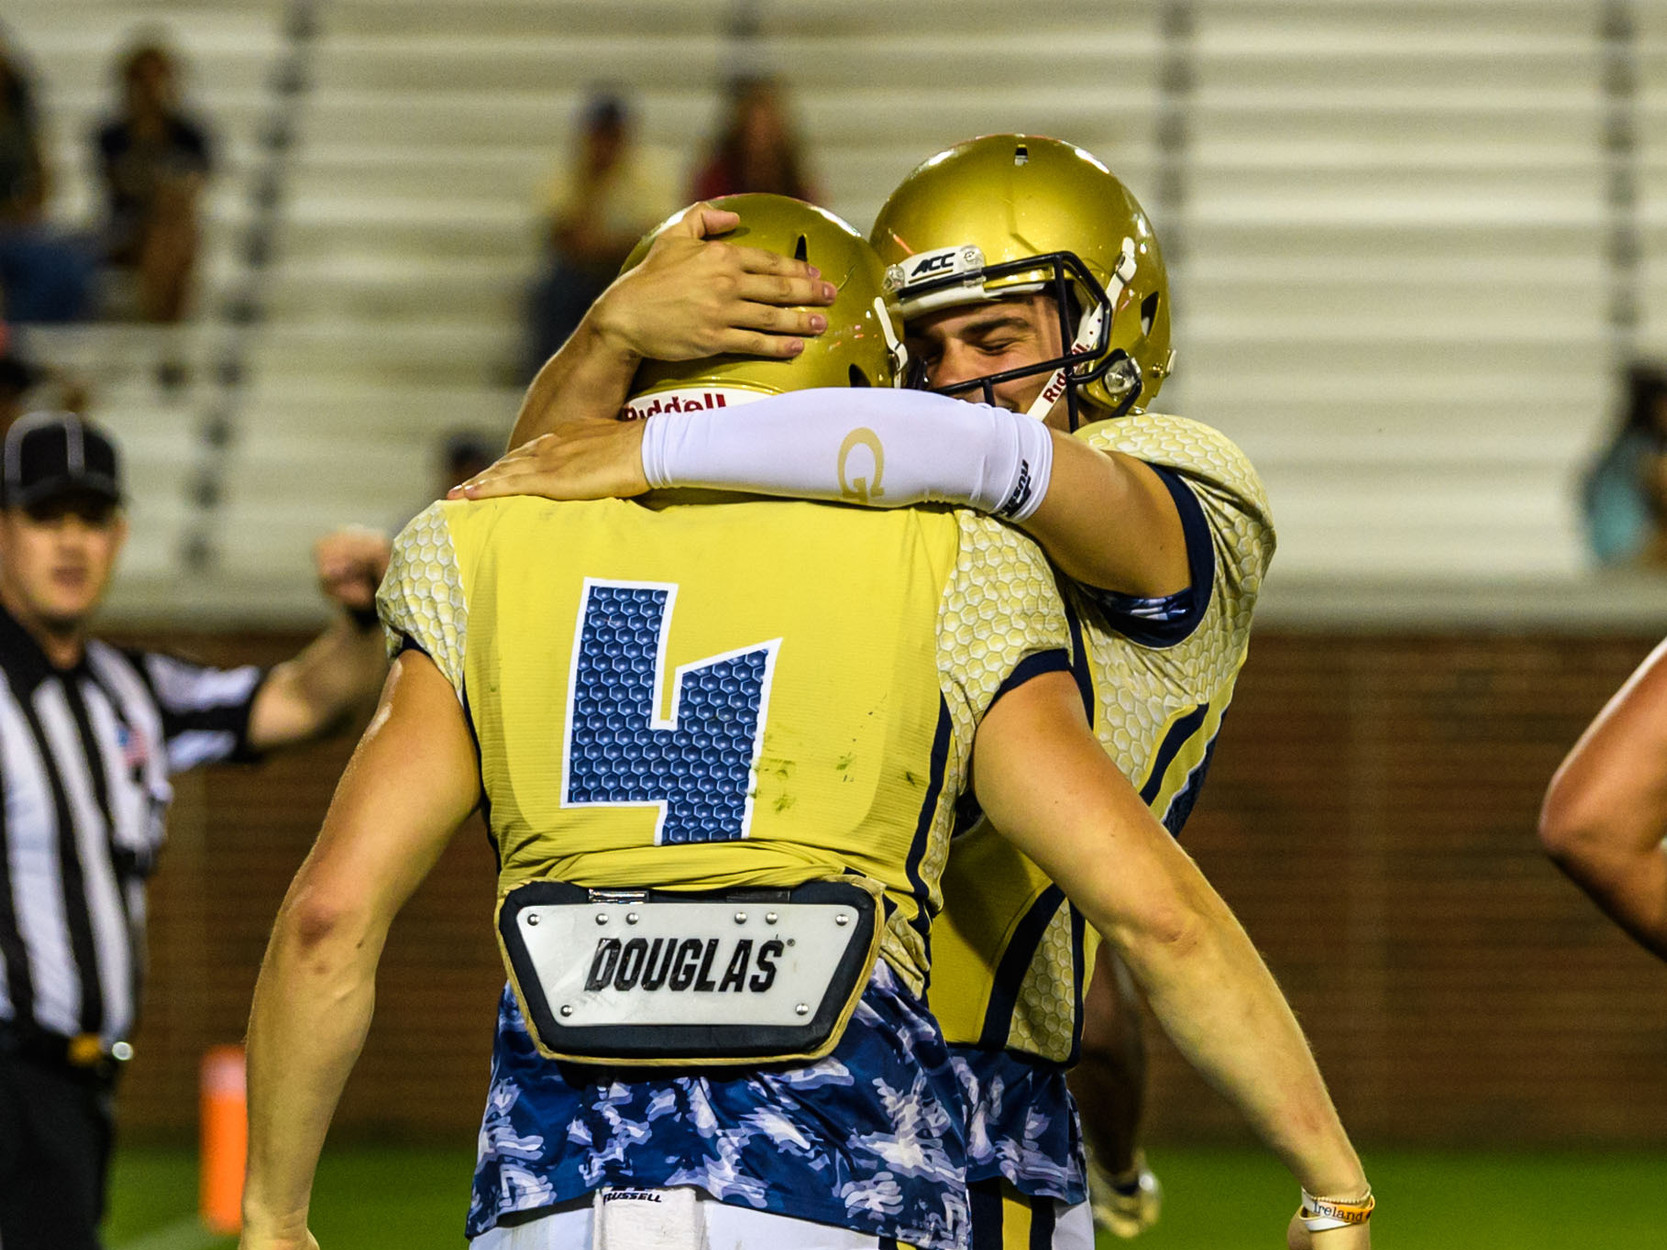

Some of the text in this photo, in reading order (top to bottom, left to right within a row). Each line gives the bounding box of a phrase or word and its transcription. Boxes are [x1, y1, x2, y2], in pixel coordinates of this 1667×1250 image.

[911, 252, 956, 277] ACC
[560, 577, 784, 848] 4
[584, 937, 785, 993] DOUGLAS
[603, 1192, 662, 1206] RUSSELL
[1313, 1201, 1363, 1222] Ireland
